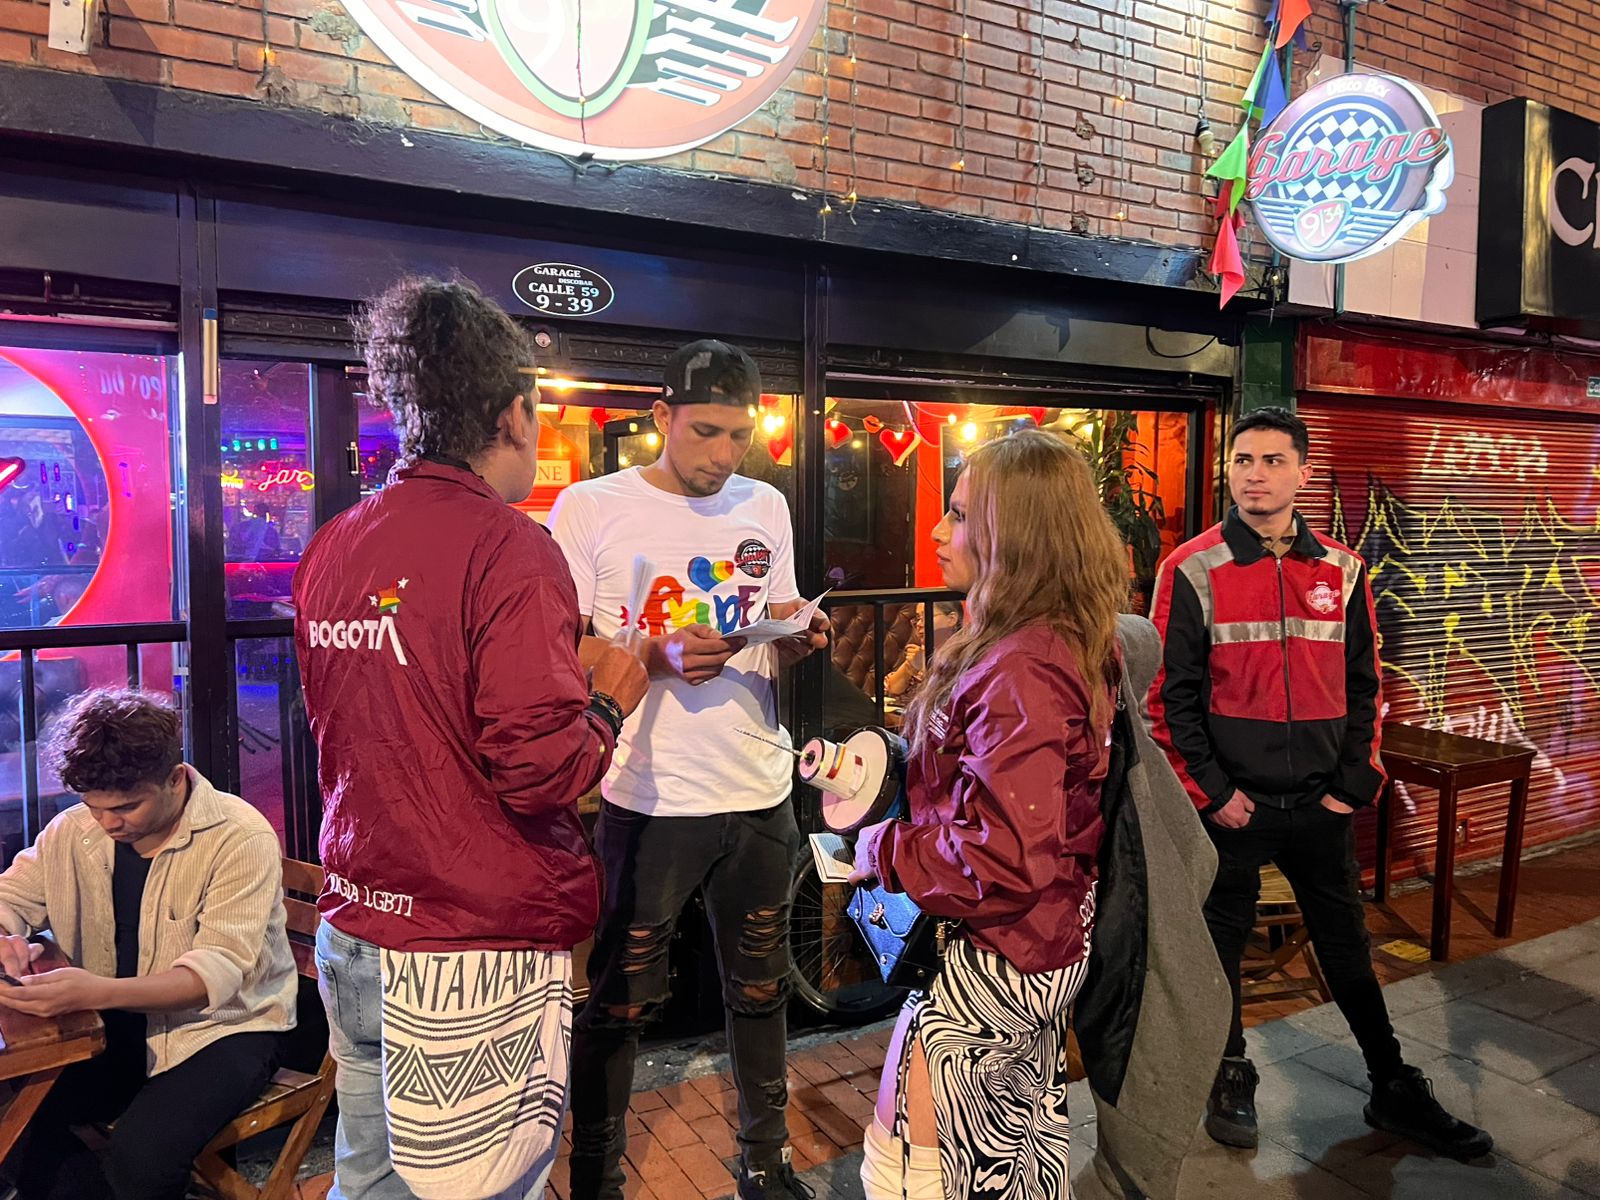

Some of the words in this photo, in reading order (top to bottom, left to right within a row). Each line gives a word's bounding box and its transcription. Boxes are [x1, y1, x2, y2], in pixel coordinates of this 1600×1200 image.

[1326, 79, 1362, 96] Disco
[1364, 77, 1392, 98] Bar
[1245, 128, 1450, 200] Garage
[533, 266, 582, 278] GARAGE
[528, 282, 576, 296] CALLE
[581, 286, 600, 298] 59
[558, 278, 594, 287] DISCOBAR
[536, 294, 550, 309] 9
[567, 297, 594, 312] 39
[363, 885, 414, 917] LGBTI
[384, 950, 465, 1012] SANTA
